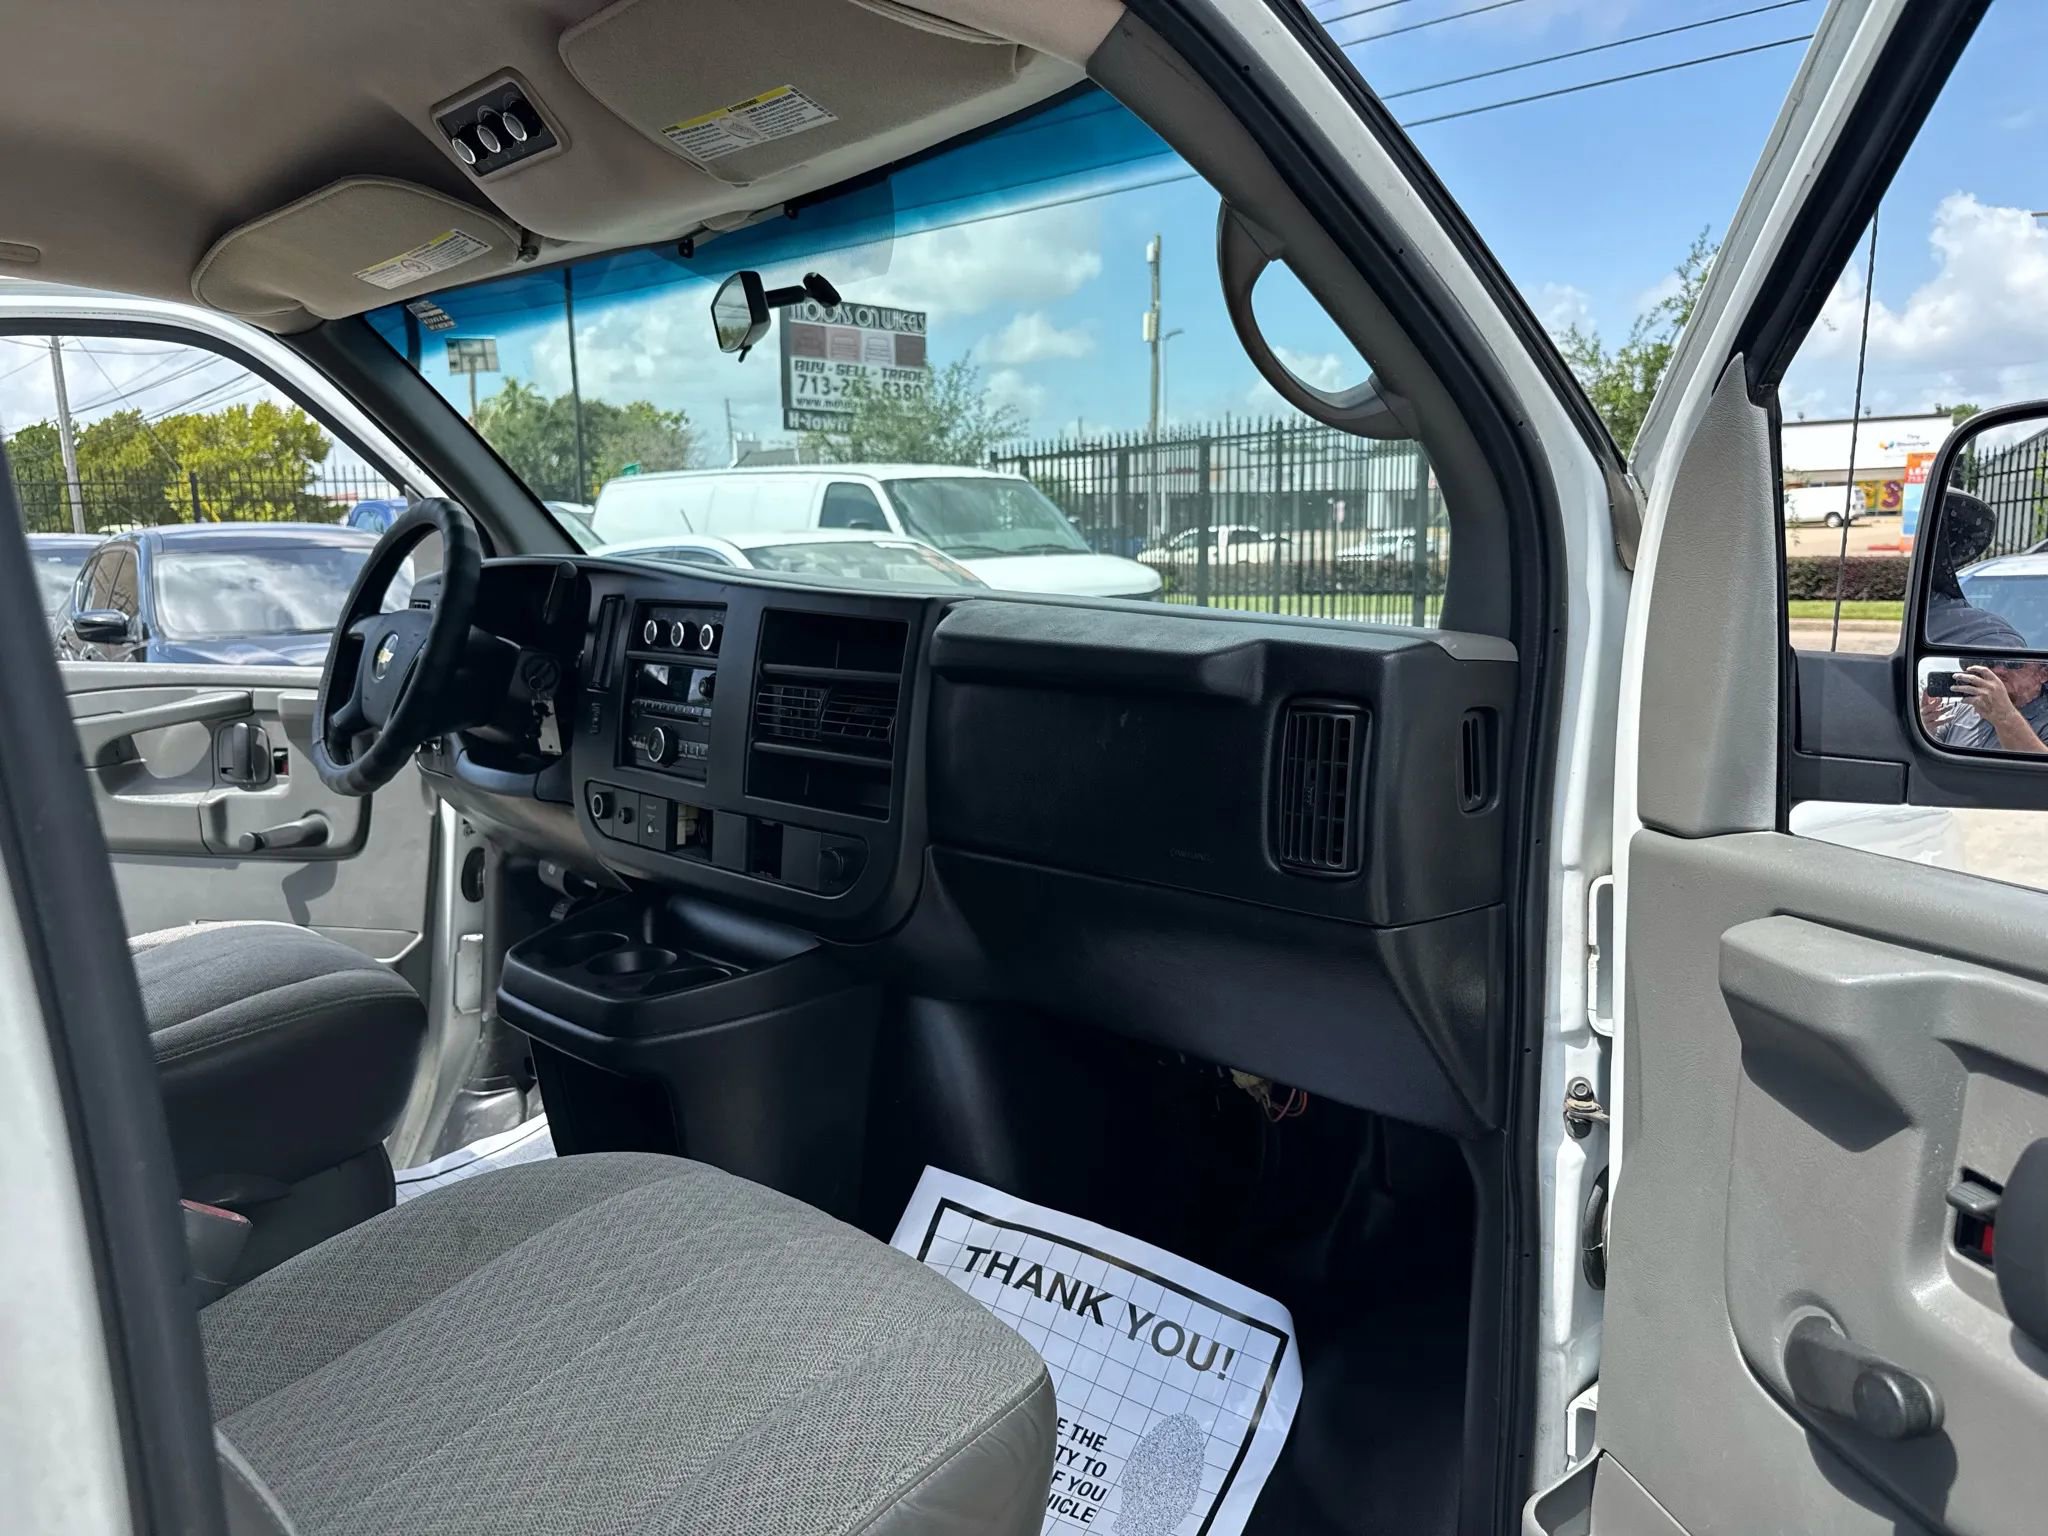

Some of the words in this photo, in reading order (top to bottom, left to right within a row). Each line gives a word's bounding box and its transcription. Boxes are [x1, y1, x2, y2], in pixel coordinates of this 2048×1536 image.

[795, 360, 825, 374] BUY
[836, 363, 868, 378] SELL
[881, 367, 925, 383] TRADE
[964, 1245, 1114, 1327] THANK
[1127, 1302, 1236, 1381] YOU!
[1071, 1423, 1107, 1453] THE
[1083, 1456, 1107, 1478] TO
[1068, 1475, 1107, 1502] YOU
